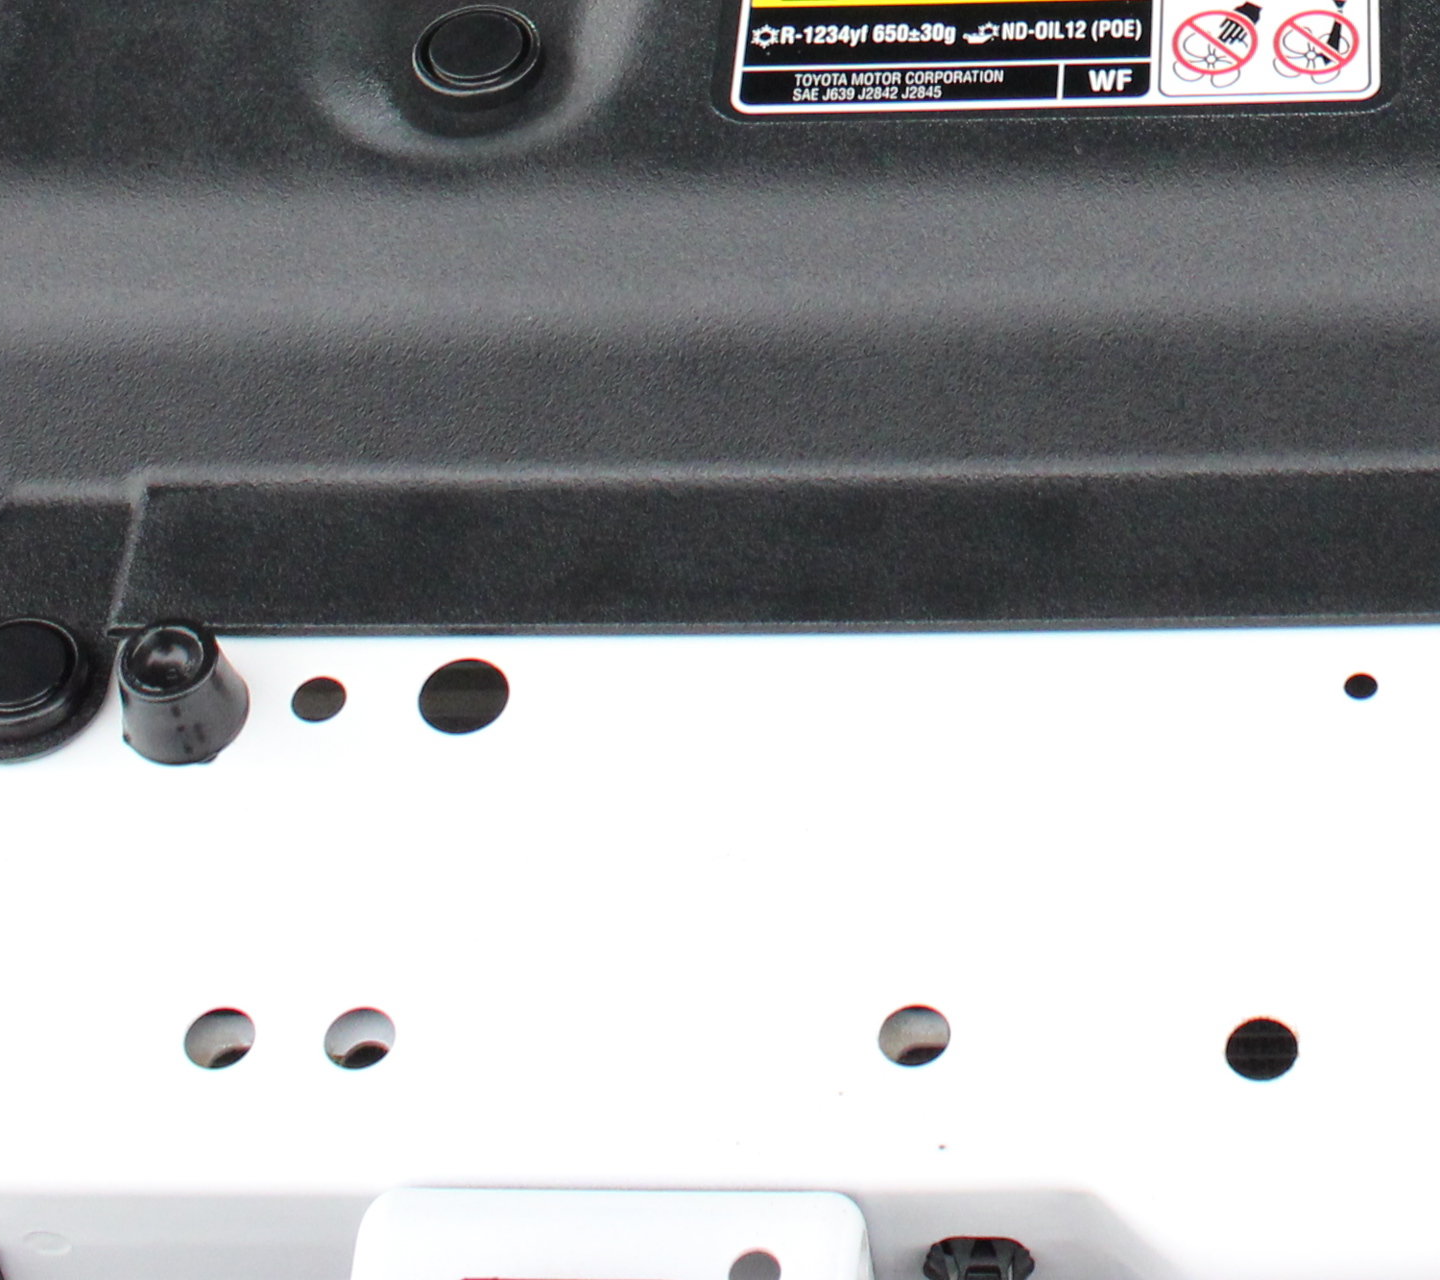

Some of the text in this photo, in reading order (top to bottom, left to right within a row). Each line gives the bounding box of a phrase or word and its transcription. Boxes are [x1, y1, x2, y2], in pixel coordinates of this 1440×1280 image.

[779, 23, 868, 47] R-1234yf
[871, 24, 957, 46] 650±30g
[1090, 18, 1143, 42] (POE)
[794, 69, 1005, 88] TOYOTA MOTOR CORPORATION
[1088, 68, 1133, 93] WF
[792, 85, 943, 102] SAE J639 J2842 J2845
